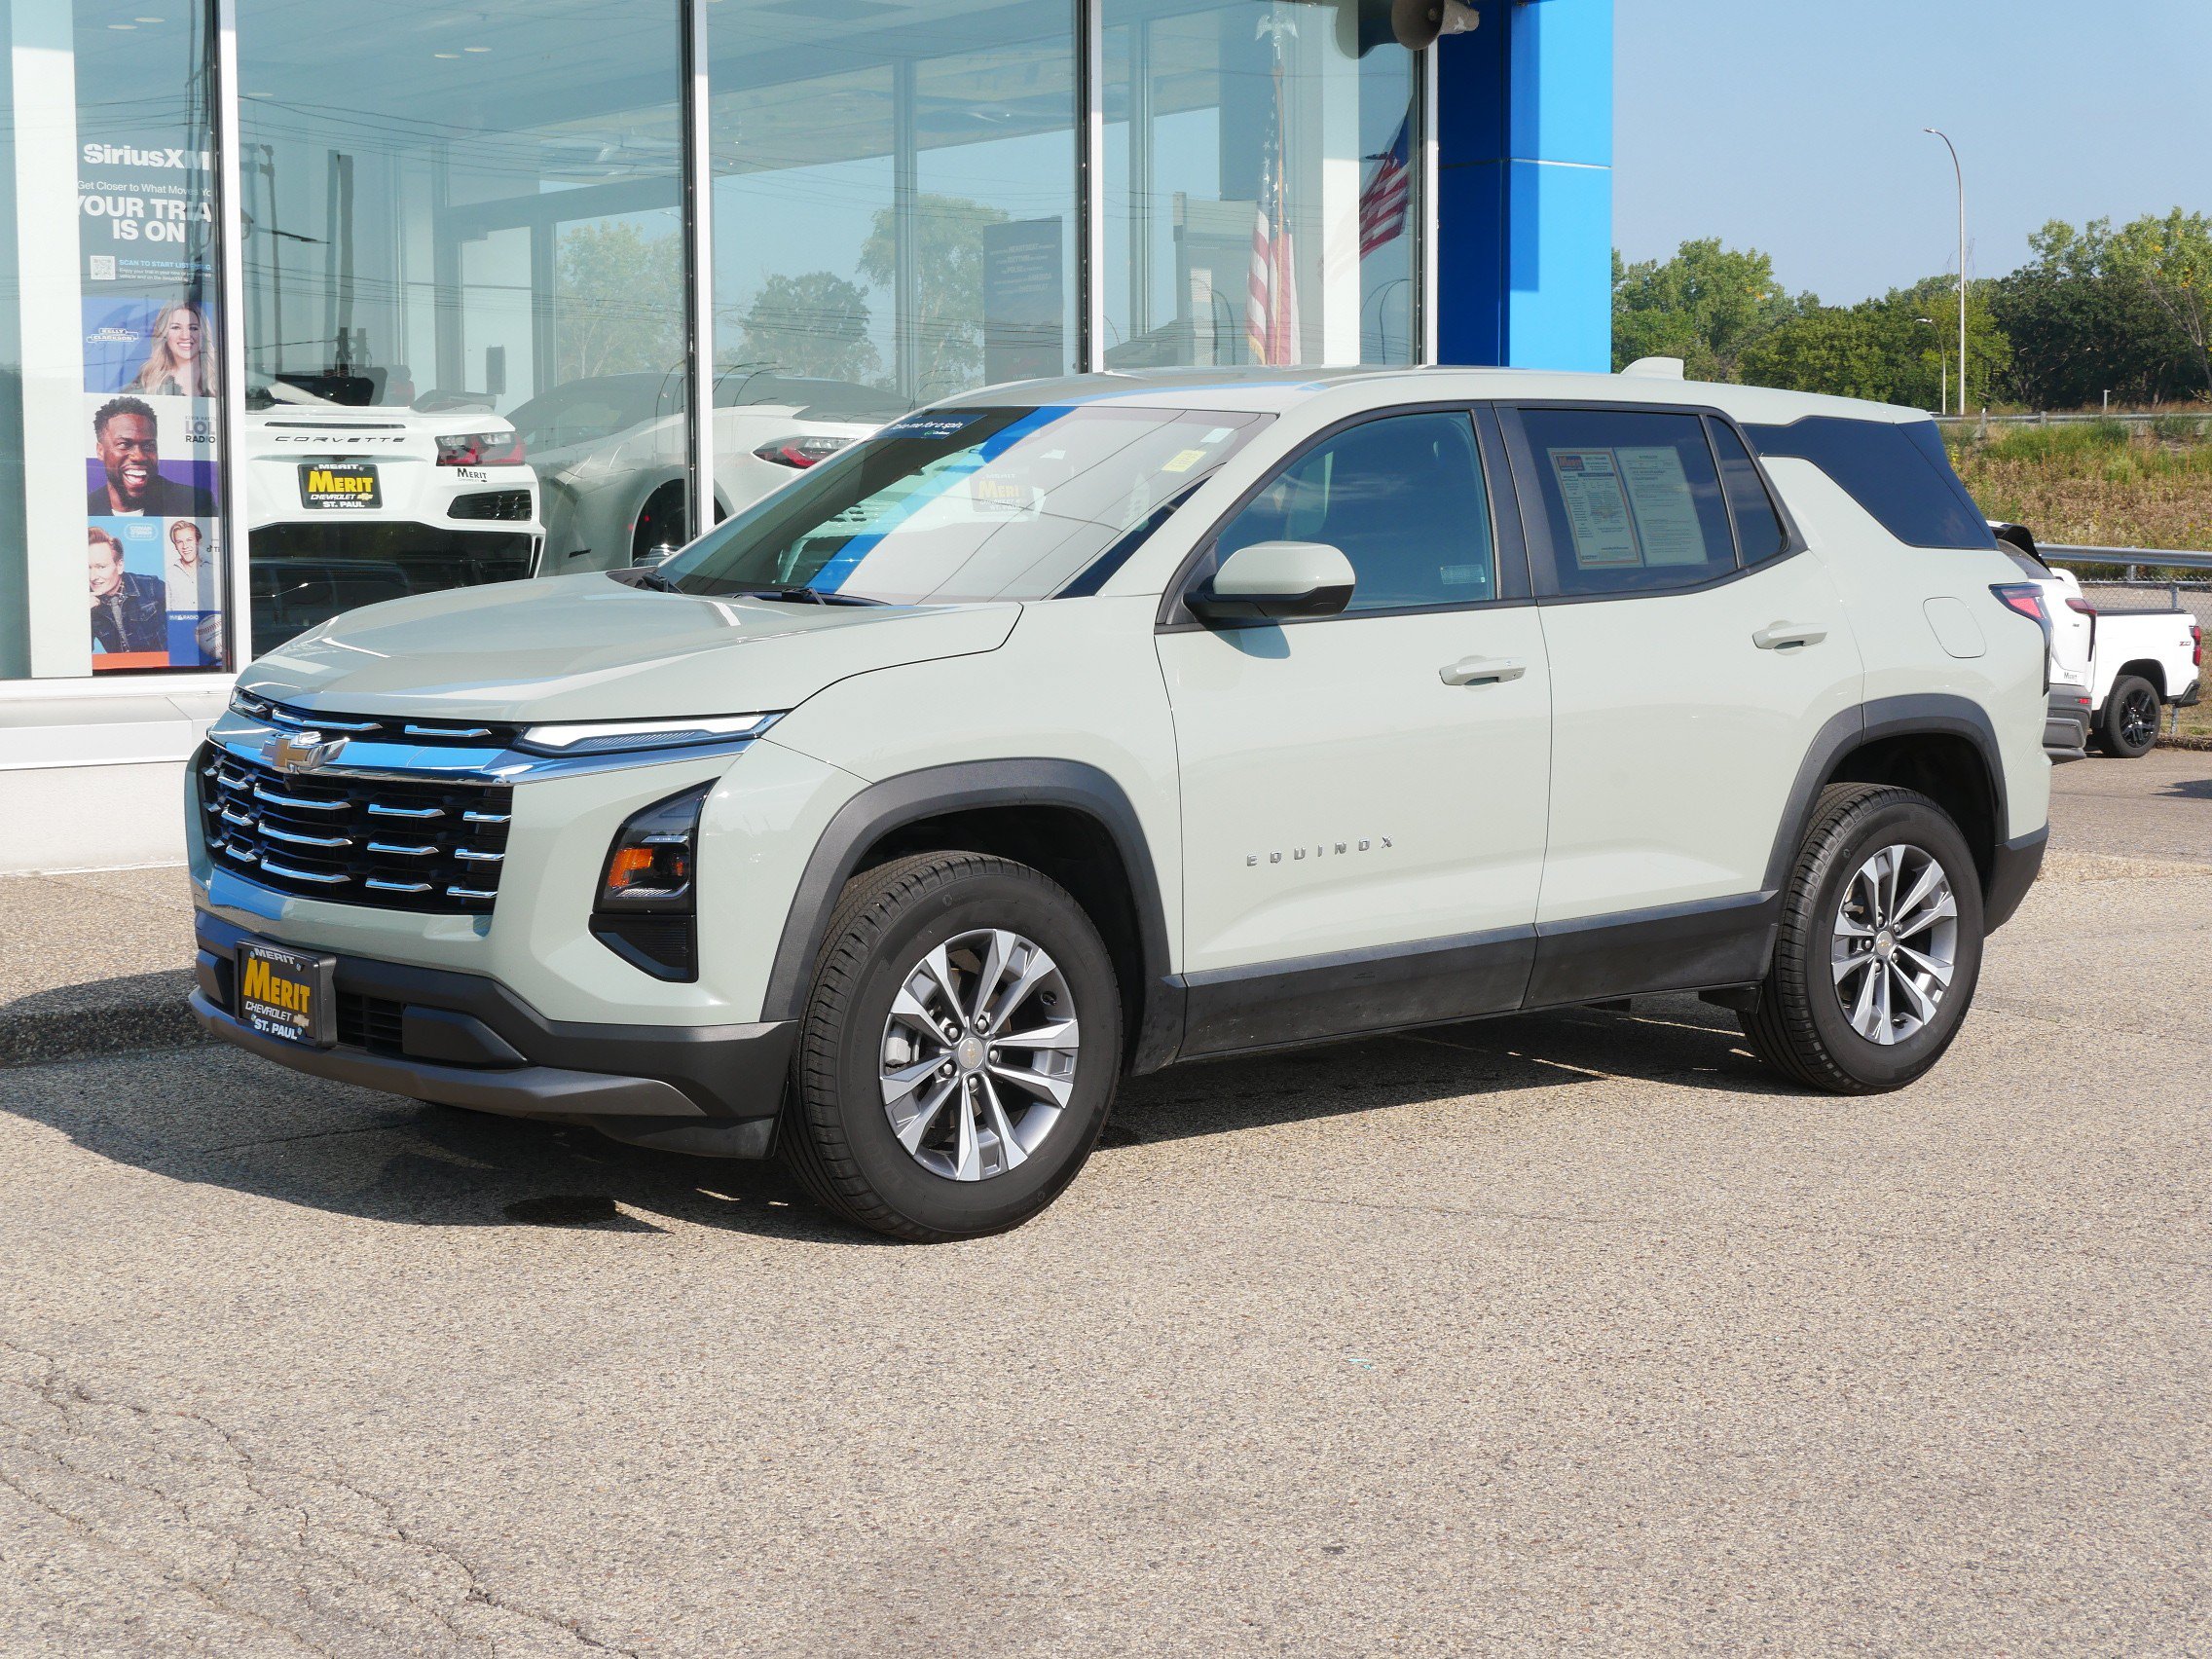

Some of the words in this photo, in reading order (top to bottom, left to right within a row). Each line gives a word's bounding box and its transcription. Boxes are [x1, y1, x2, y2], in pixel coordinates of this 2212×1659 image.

[84, 143, 209, 170] SiriusXM
[78, 181, 94, 190] Get
[96, 181, 128, 191] Closer
[129, 183, 139, 192] to
[141, 184, 166, 194] What
[113, 218, 139, 240] IS
[144, 220, 186, 242] ON
[185, 420, 215, 435] LOL
[308, 470, 373, 493] MERIT
[457, 467, 487, 479] MERIT
[1246, 834, 1393, 866] EQUINOX
[253, 948, 295, 964] MERIT
[243, 958, 310, 1013] MERIT
[245, 1001, 291, 1021] CHEVROLET
[254, 1018, 270, 1032] ST.
[272, 1022, 297, 1040] PAUL
